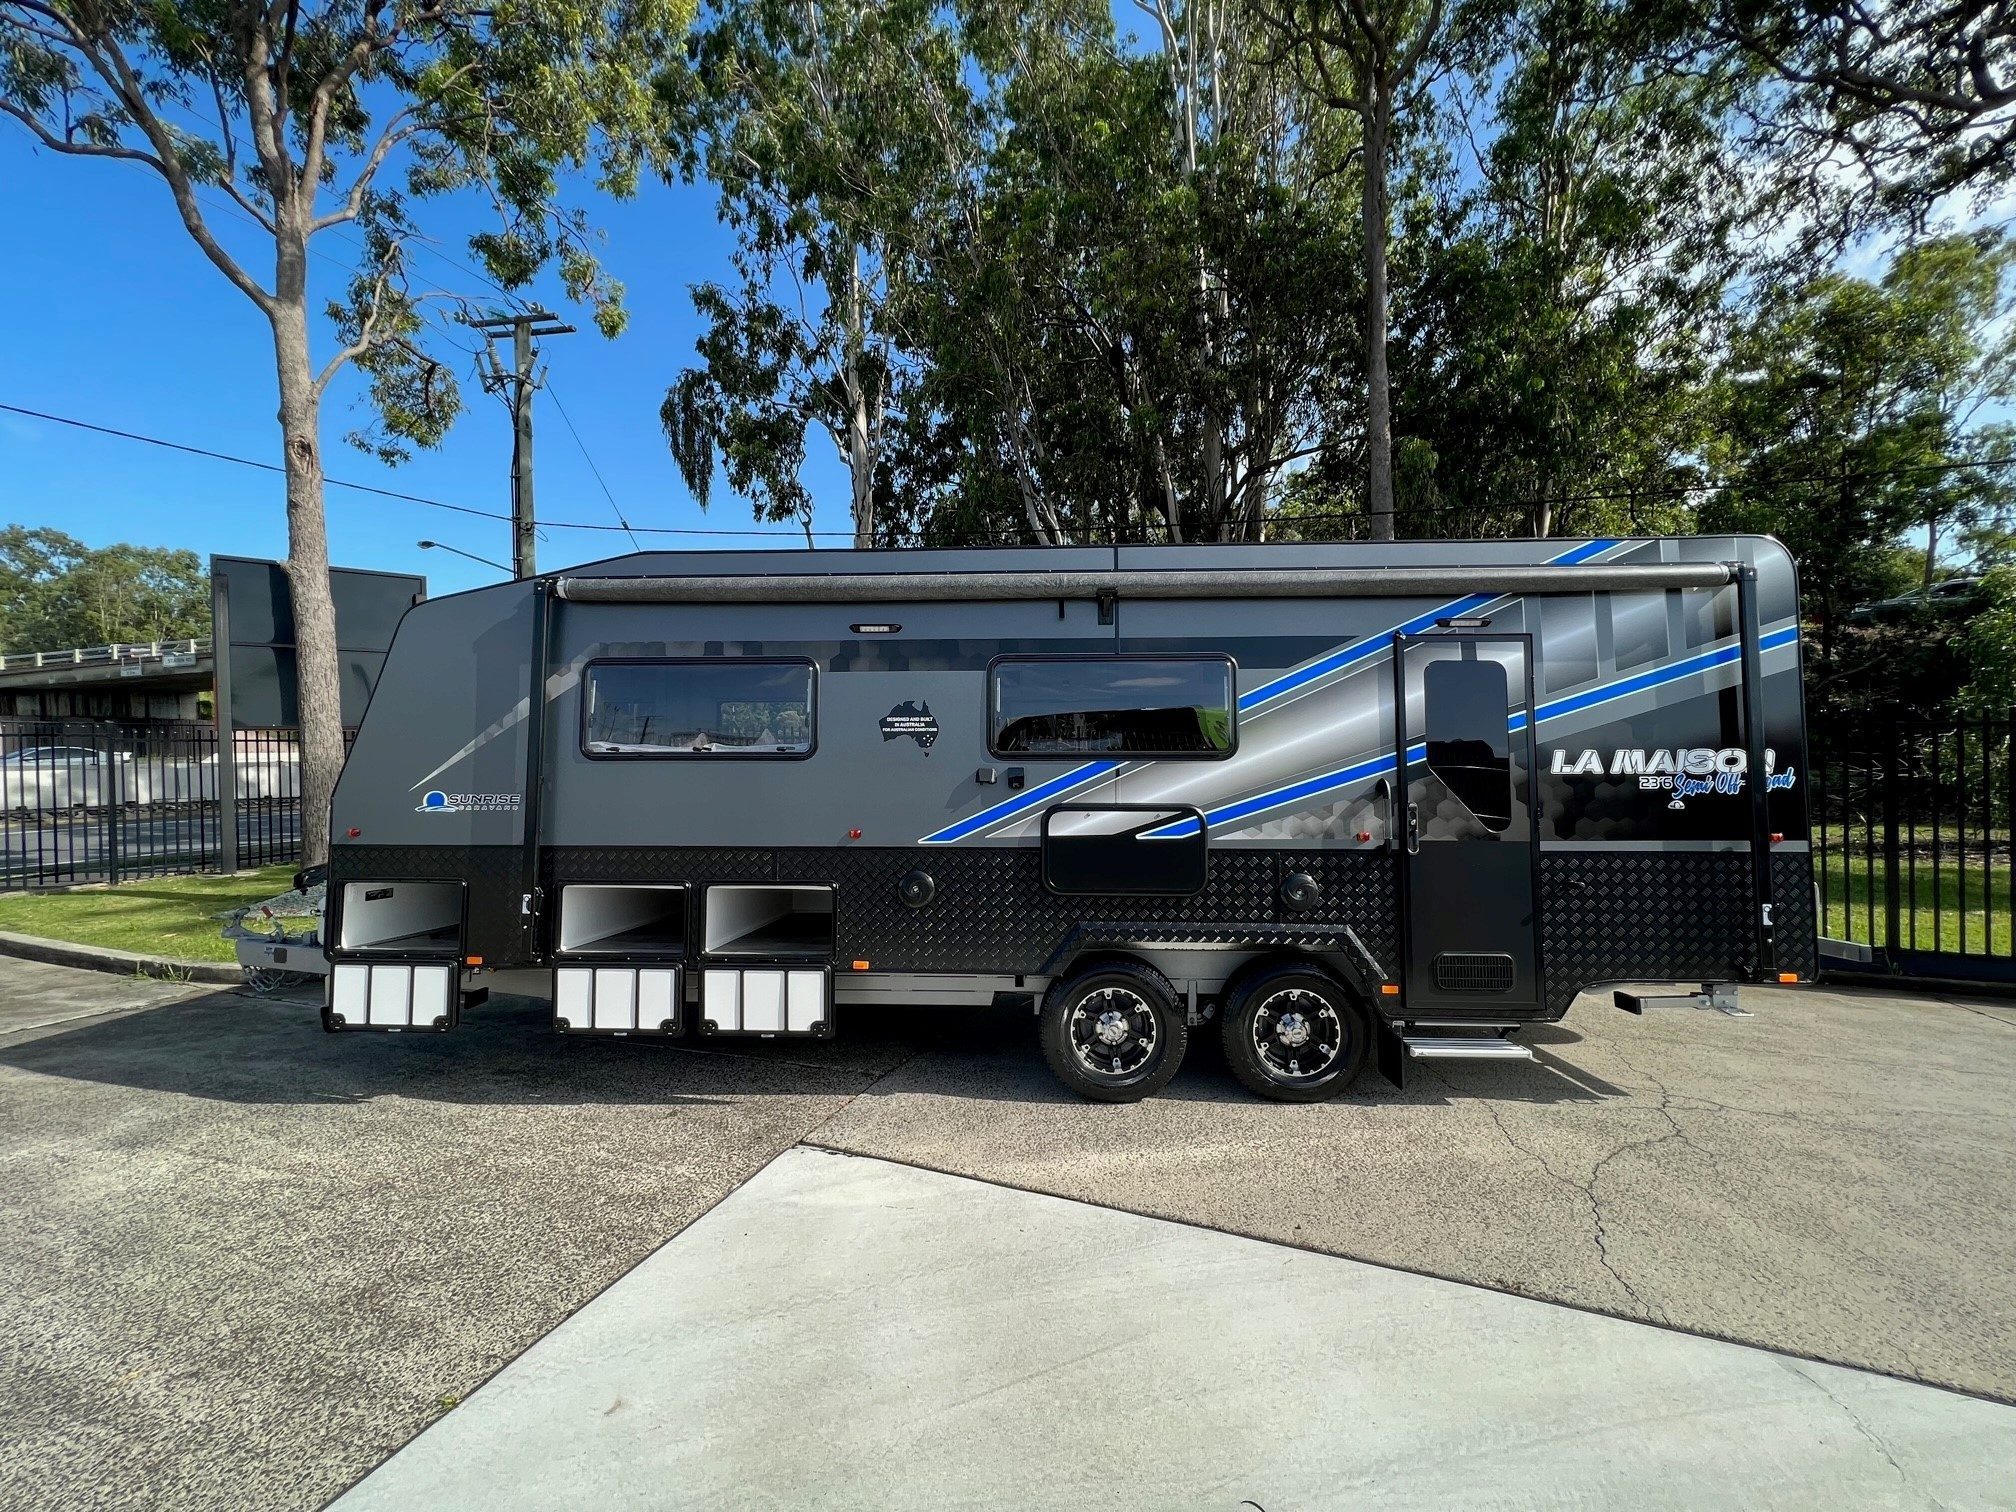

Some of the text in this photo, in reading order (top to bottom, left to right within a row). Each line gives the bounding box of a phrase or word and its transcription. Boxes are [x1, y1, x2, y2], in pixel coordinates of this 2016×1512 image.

[1550, 749, 1604, 775] LA
[1671, 773, 1714, 799] Semi
[448, 794, 520, 805] SUNRISE
